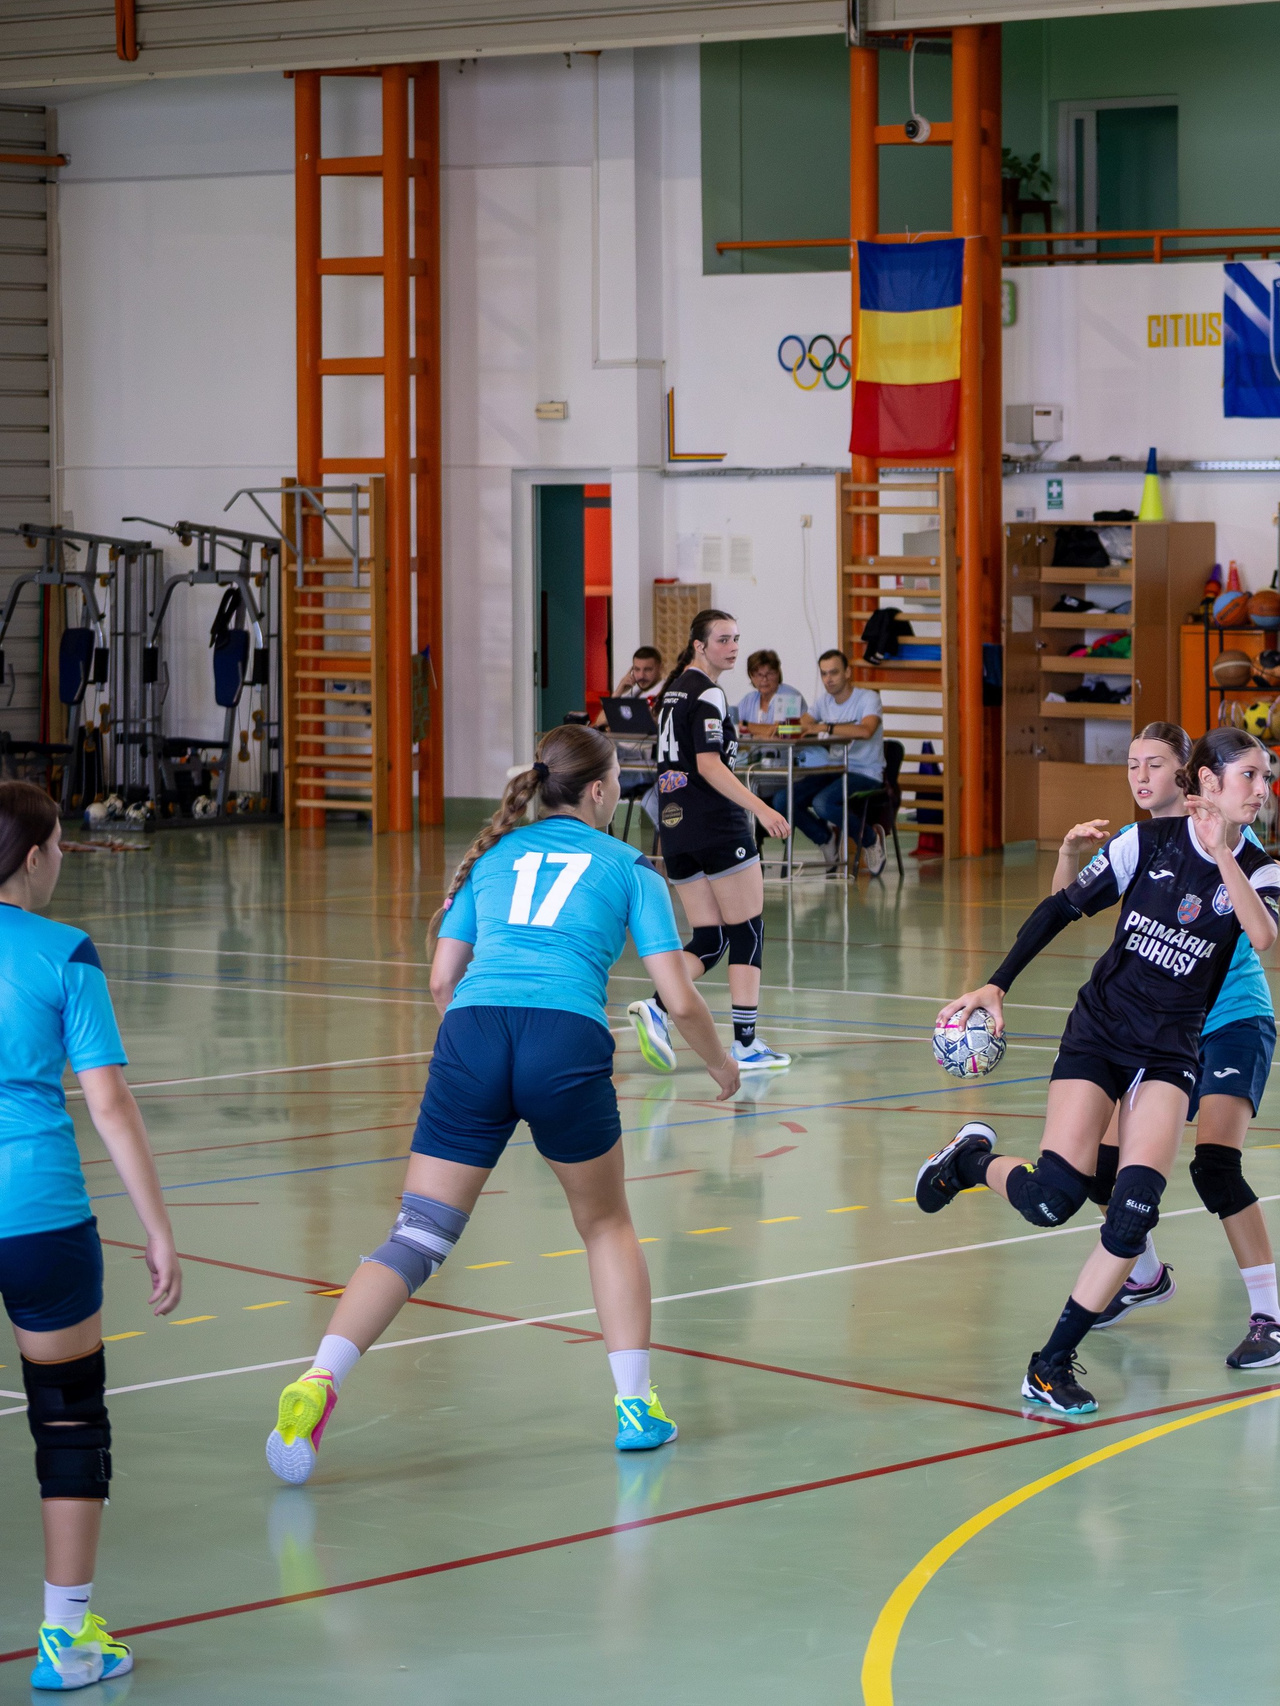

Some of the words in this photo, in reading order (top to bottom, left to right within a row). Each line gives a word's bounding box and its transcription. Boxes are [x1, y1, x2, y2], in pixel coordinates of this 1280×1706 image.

[1148, 313, 1222, 348] CITIUS
[508, 852, 592, 926] 17
[1124, 911, 1216, 958] PRIMĂRIA
[1125, 933, 1197, 976] BUHUȘI
[1039, 1202, 1058, 1222] SELECT
[1126, 1199, 1151, 1213] SELECT
